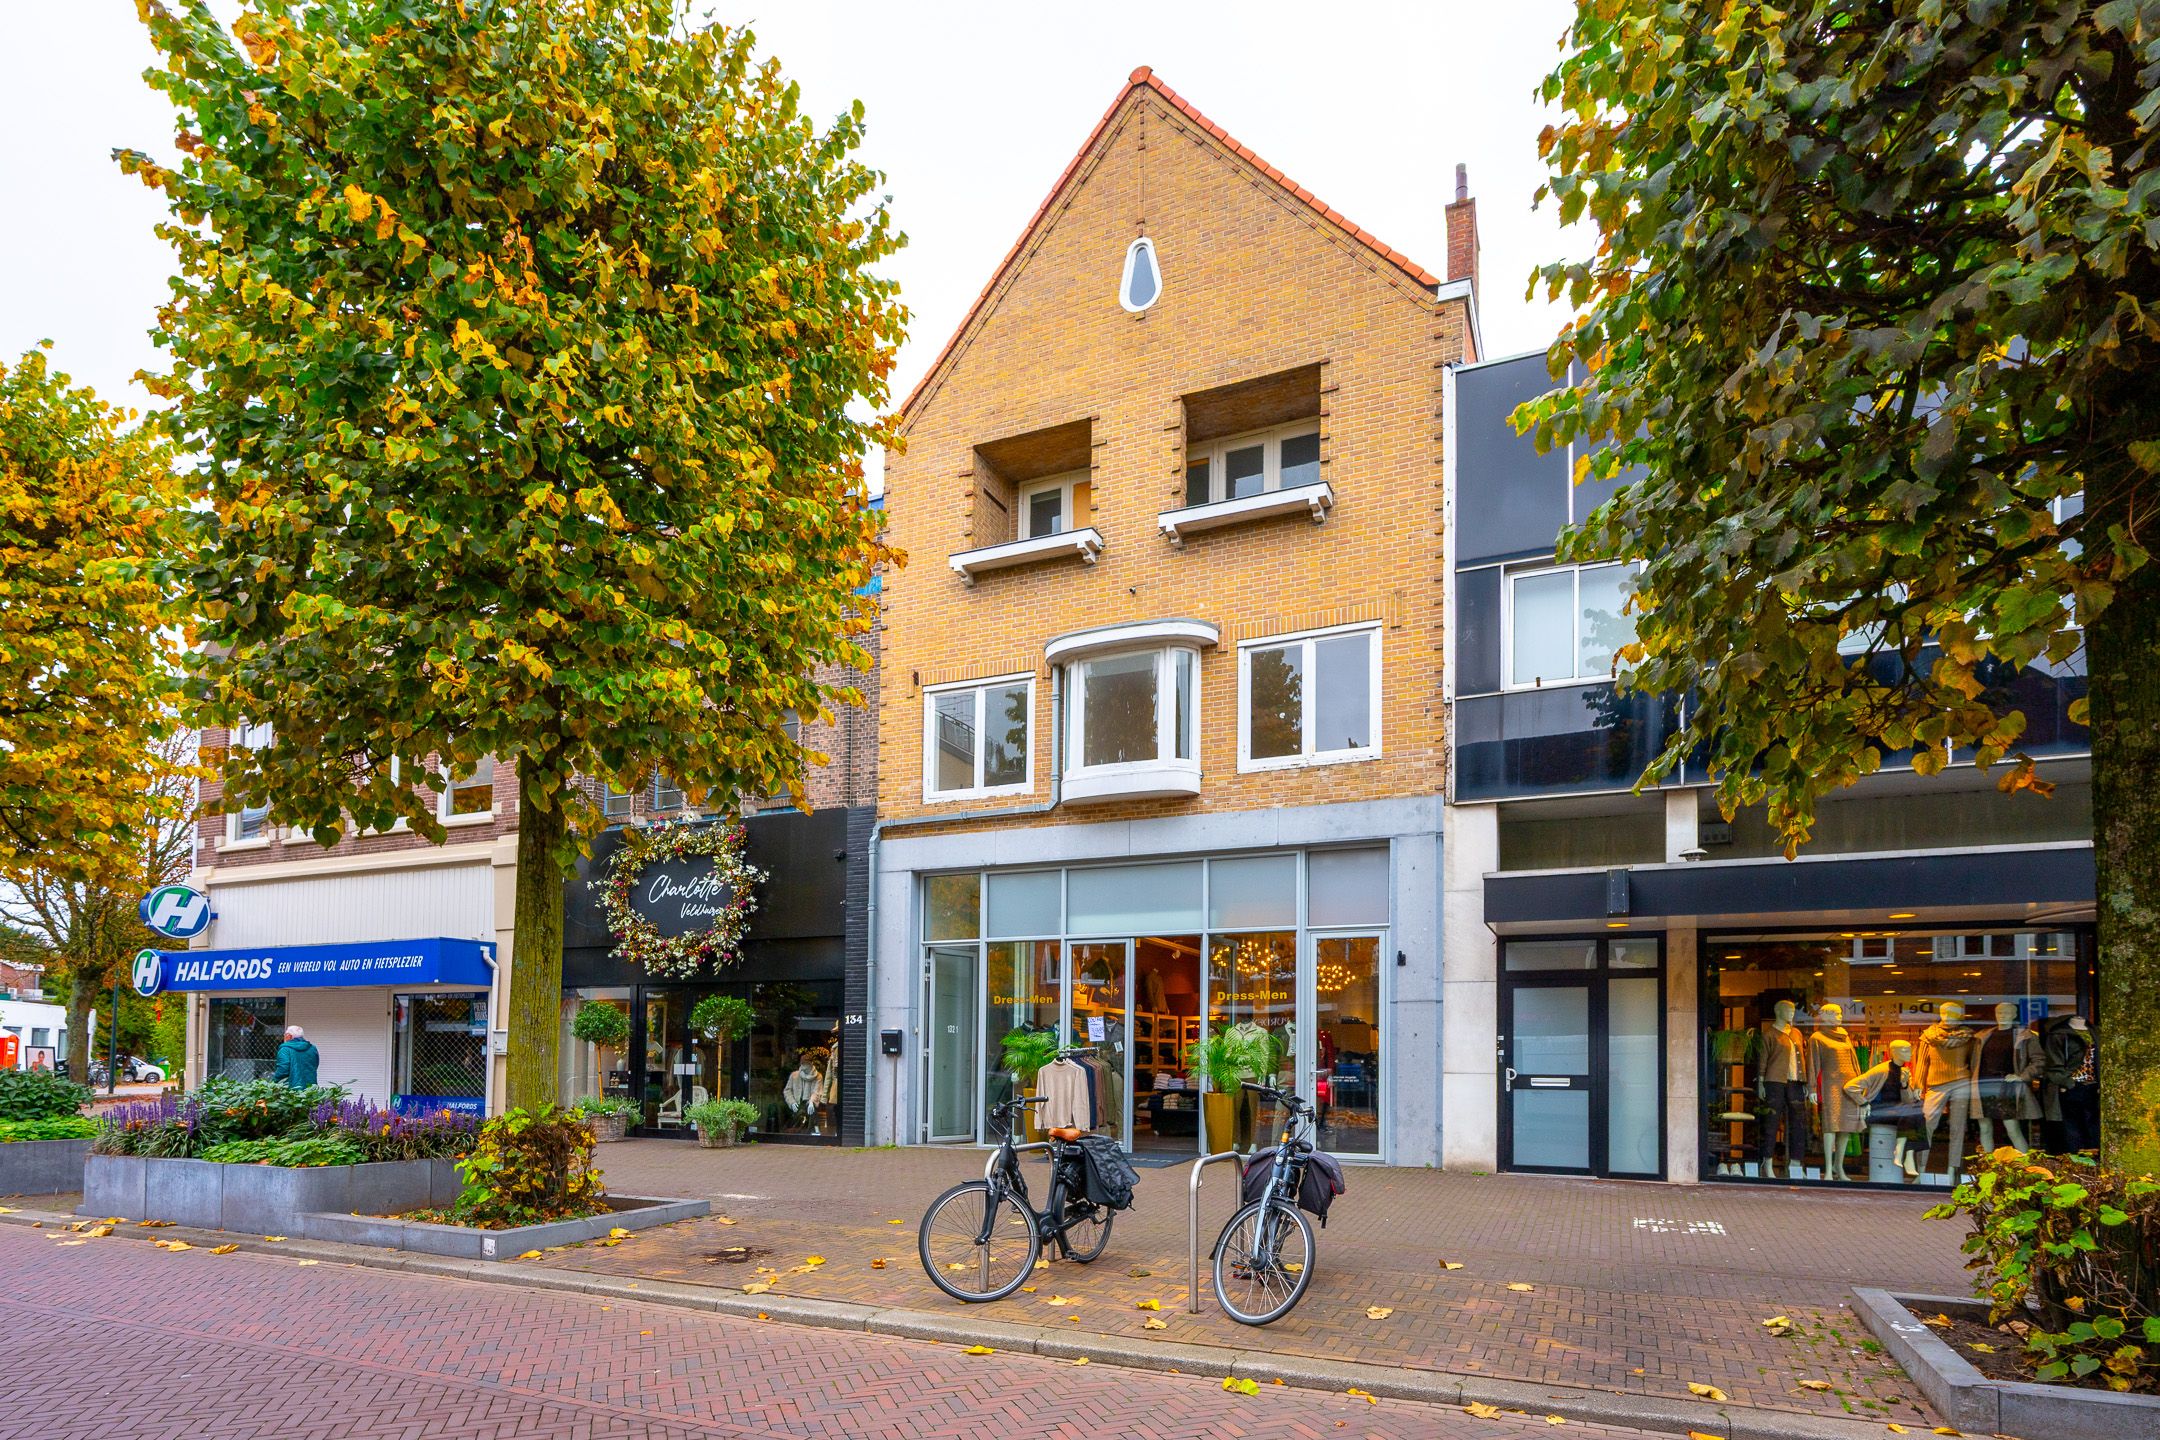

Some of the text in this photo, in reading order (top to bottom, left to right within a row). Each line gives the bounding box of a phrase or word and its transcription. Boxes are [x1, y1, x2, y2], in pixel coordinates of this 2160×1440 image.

[648, 874, 723, 903] Charlotte
[151, 892, 208, 930] H
[133, 955, 160, 988] H
[174, 955, 424, 982] HALFORDS EEN WERELD VOL AUTO EN FIETSPLEZIER
[993, 995, 1053, 1005] Dress-Men
[1217, 990, 1288, 1001] Dress-Men
[845, 1014, 863, 1025] 134
